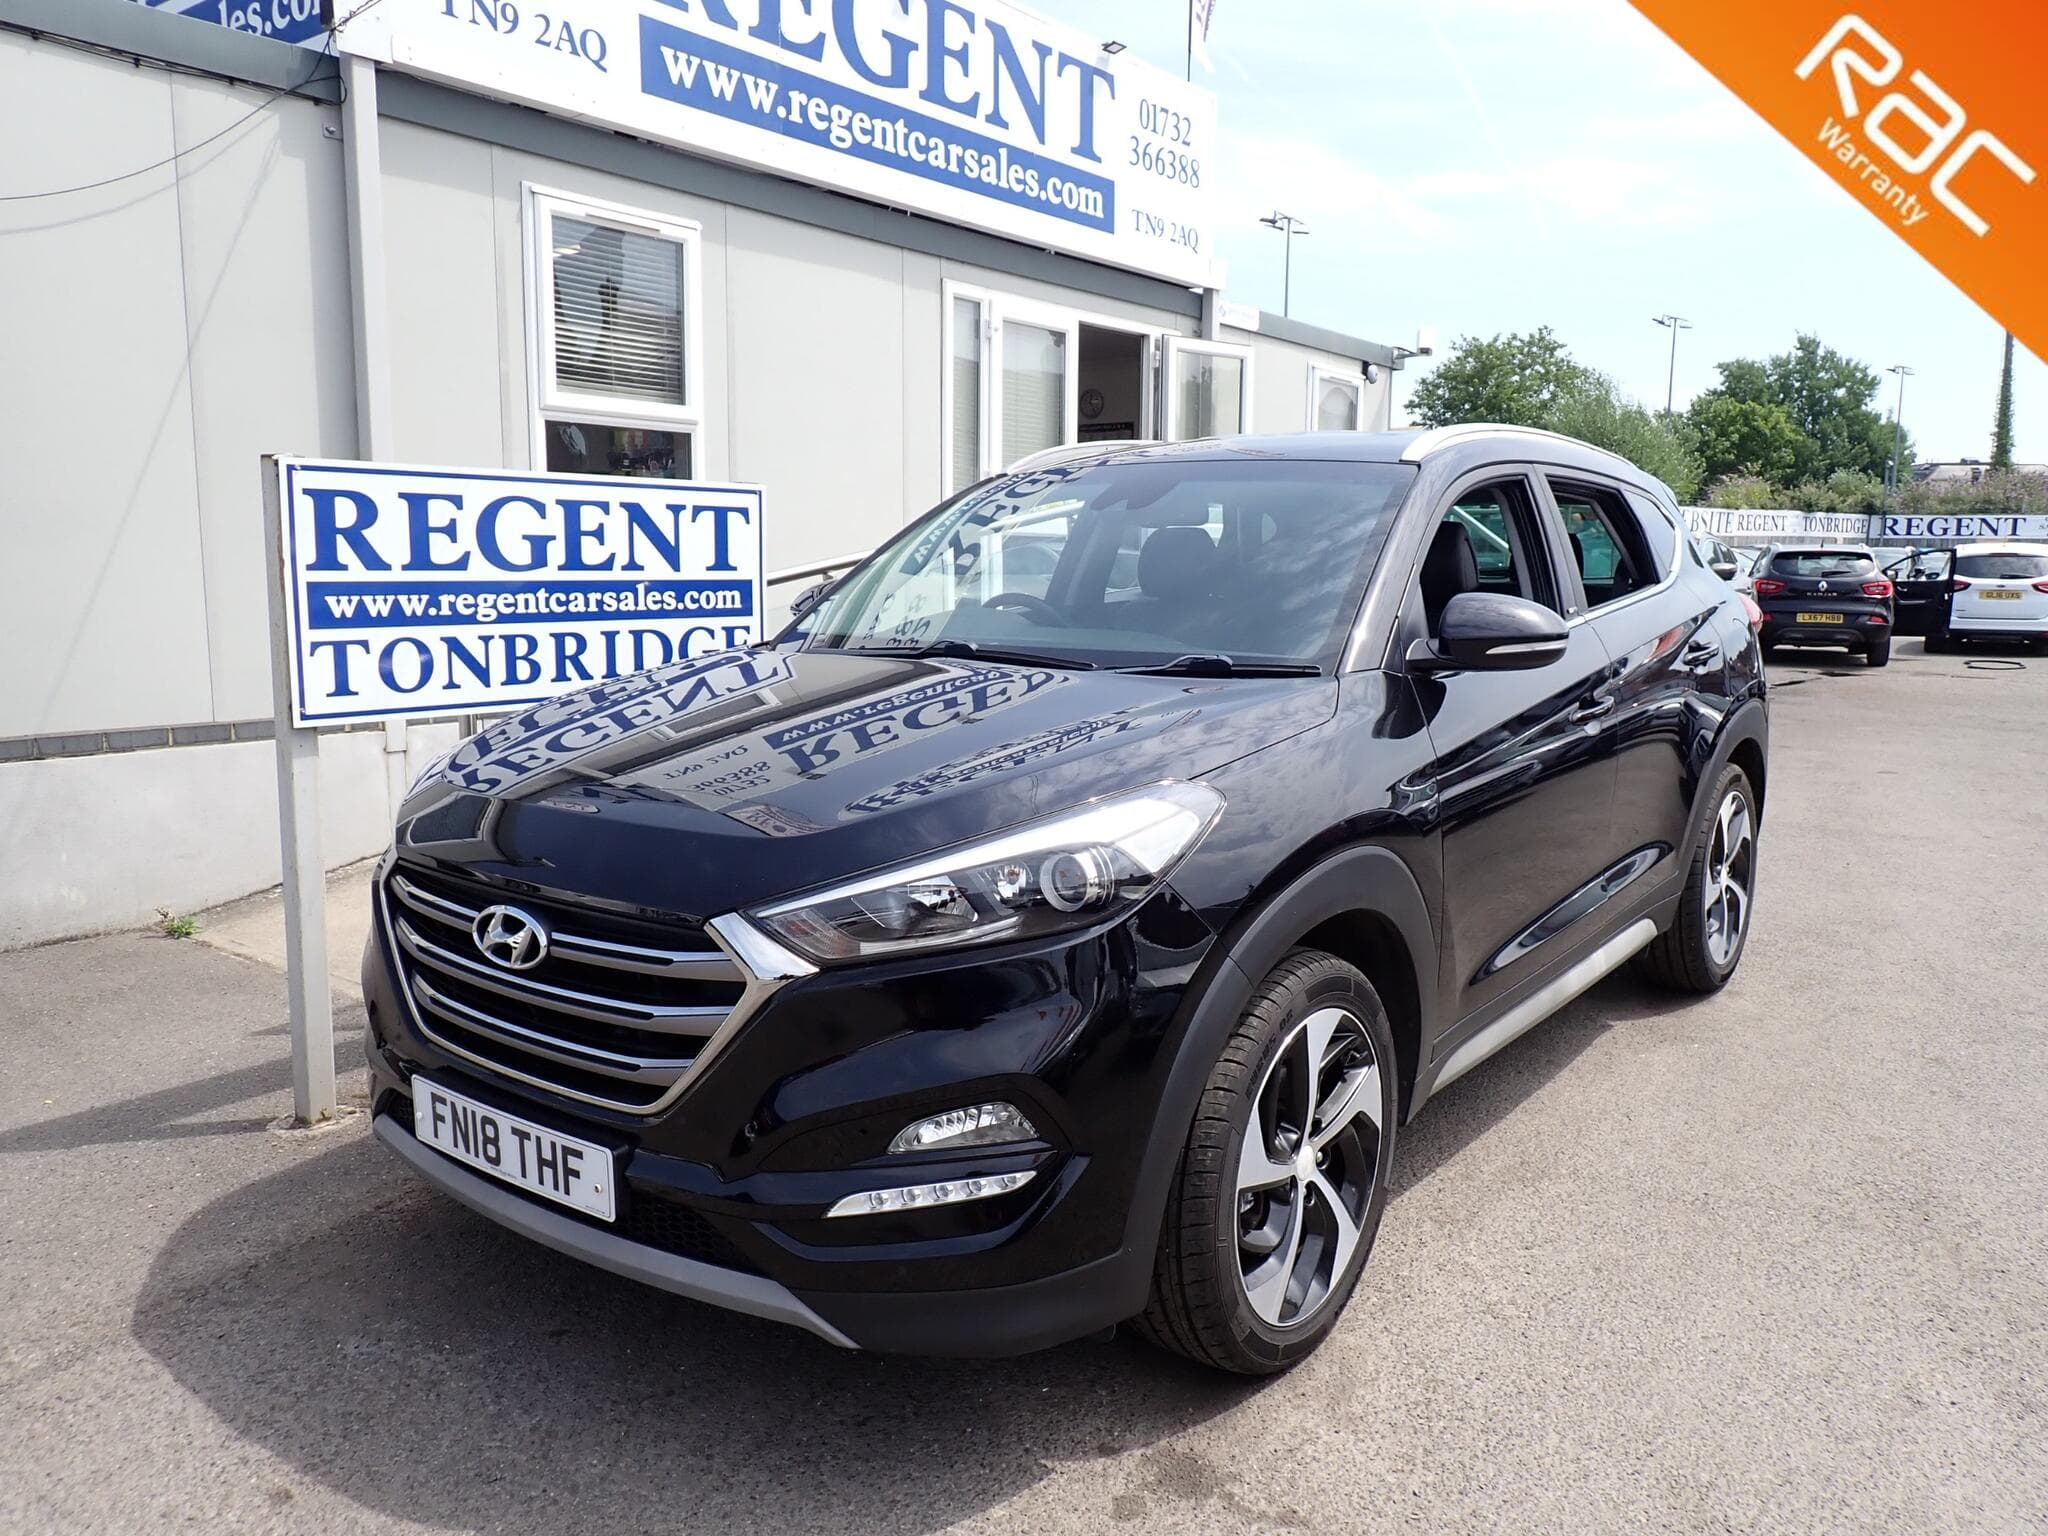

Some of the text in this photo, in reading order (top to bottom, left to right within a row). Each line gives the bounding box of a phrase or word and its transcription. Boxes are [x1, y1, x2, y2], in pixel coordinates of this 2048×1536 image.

[534, 13, 608, 73] 2AQ
[637, 0, 1116, 164] GENT
[660, 44, 1105, 219] www.regentcarsales.com
[1139, 98, 1192, 147] 01732
[1129, 135, 1201, 189] 366388
[1131, 208, 1199, 254] TN9 2AQ
[302, 487, 750, 573] REGENT
[1737, 514, 1788, 532] REGENT
[1802, 515, 1868, 534] TONBRIDGE
[1879, 517, 2027, 537] REGENT
[324, 581, 743, 624] www.regentcarsales.com
[430, 1091, 584, 1197] FN18 THF
